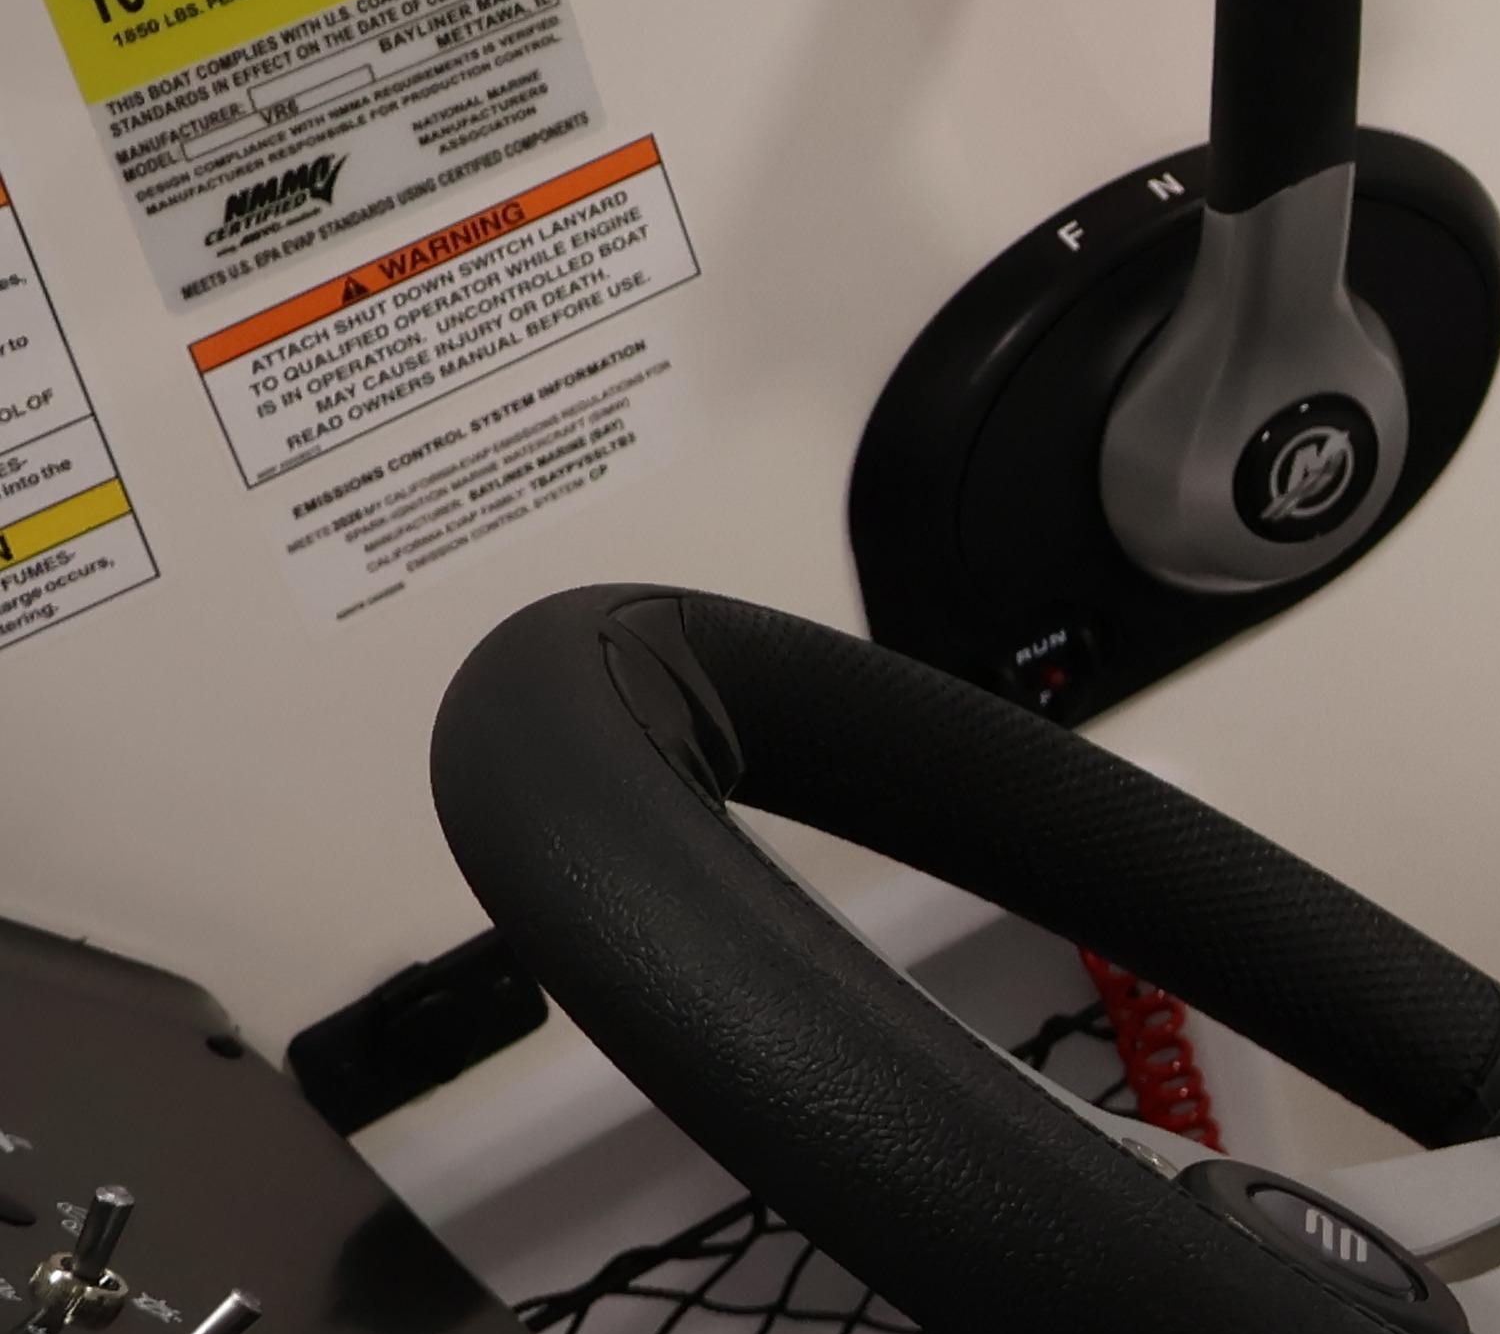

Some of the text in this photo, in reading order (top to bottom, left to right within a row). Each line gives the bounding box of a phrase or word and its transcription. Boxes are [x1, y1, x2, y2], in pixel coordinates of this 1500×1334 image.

[105, 90, 145, 116] THIS
[147, 69, 190, 101] BOAT
[195, 35, 278, 80] COMPLIES
[279, 18, 321, 45] WITH
[163, 2, 204, 28] LBS.
[377, 3, 472, 53] BAYLINER
[109, 85, 210, 138] STANDARDS
[231, 50, 291, 87] EFFECT
[322, 25, 354, 48] THE
[356, 6, 399, 35] DATE
[193, 130, 286, 177] COMPLIANCE
[288, 114, 325, 136] WITH
[373, 48, 480, 101] REQUIREMENTS
[412, 95, 483, 131] NATIONAL
[417, 82, 548, 146] MANUFACTURERS
[145, 157, 265, 216] MANUFACTURER
[267, 113, 367, 163] RESPONSIBLE
[368, 100, 399, 120] FOR
[400, 61, 491, 106] PRODUCTION
[438, 105, 536, 155] ASSOCIATION
[377, 201, 525, 280] WARNING
[1057, 173, 1185, 251] F N
[248, 206, 641, 397] TO QUALIFIED OPERATOR WHILE ENGINE
[251, 190, 628, 375] ATTACH SHUT DOWN SWITCH LANYARD
[305, 331, 427, 394] OPERATION.
[435, 250, 594, 335] UNCONTROLLED
[597, 223, 648, 259] BOAT
[285, 270, 650, 451] READ OWNERS MANUAL BEFORE USE.
[315, 383, 355, 413] MAY
[362, 349, 430, 391] CAUSE
[433, 313, 502, 358] INJURY
[508, 299, 538, 323] OR
[291, 339, 646, 520] EMISSIONS CONTROL SYSTEM INFORMATION
[1015, 628, 1067, 665] RUN
